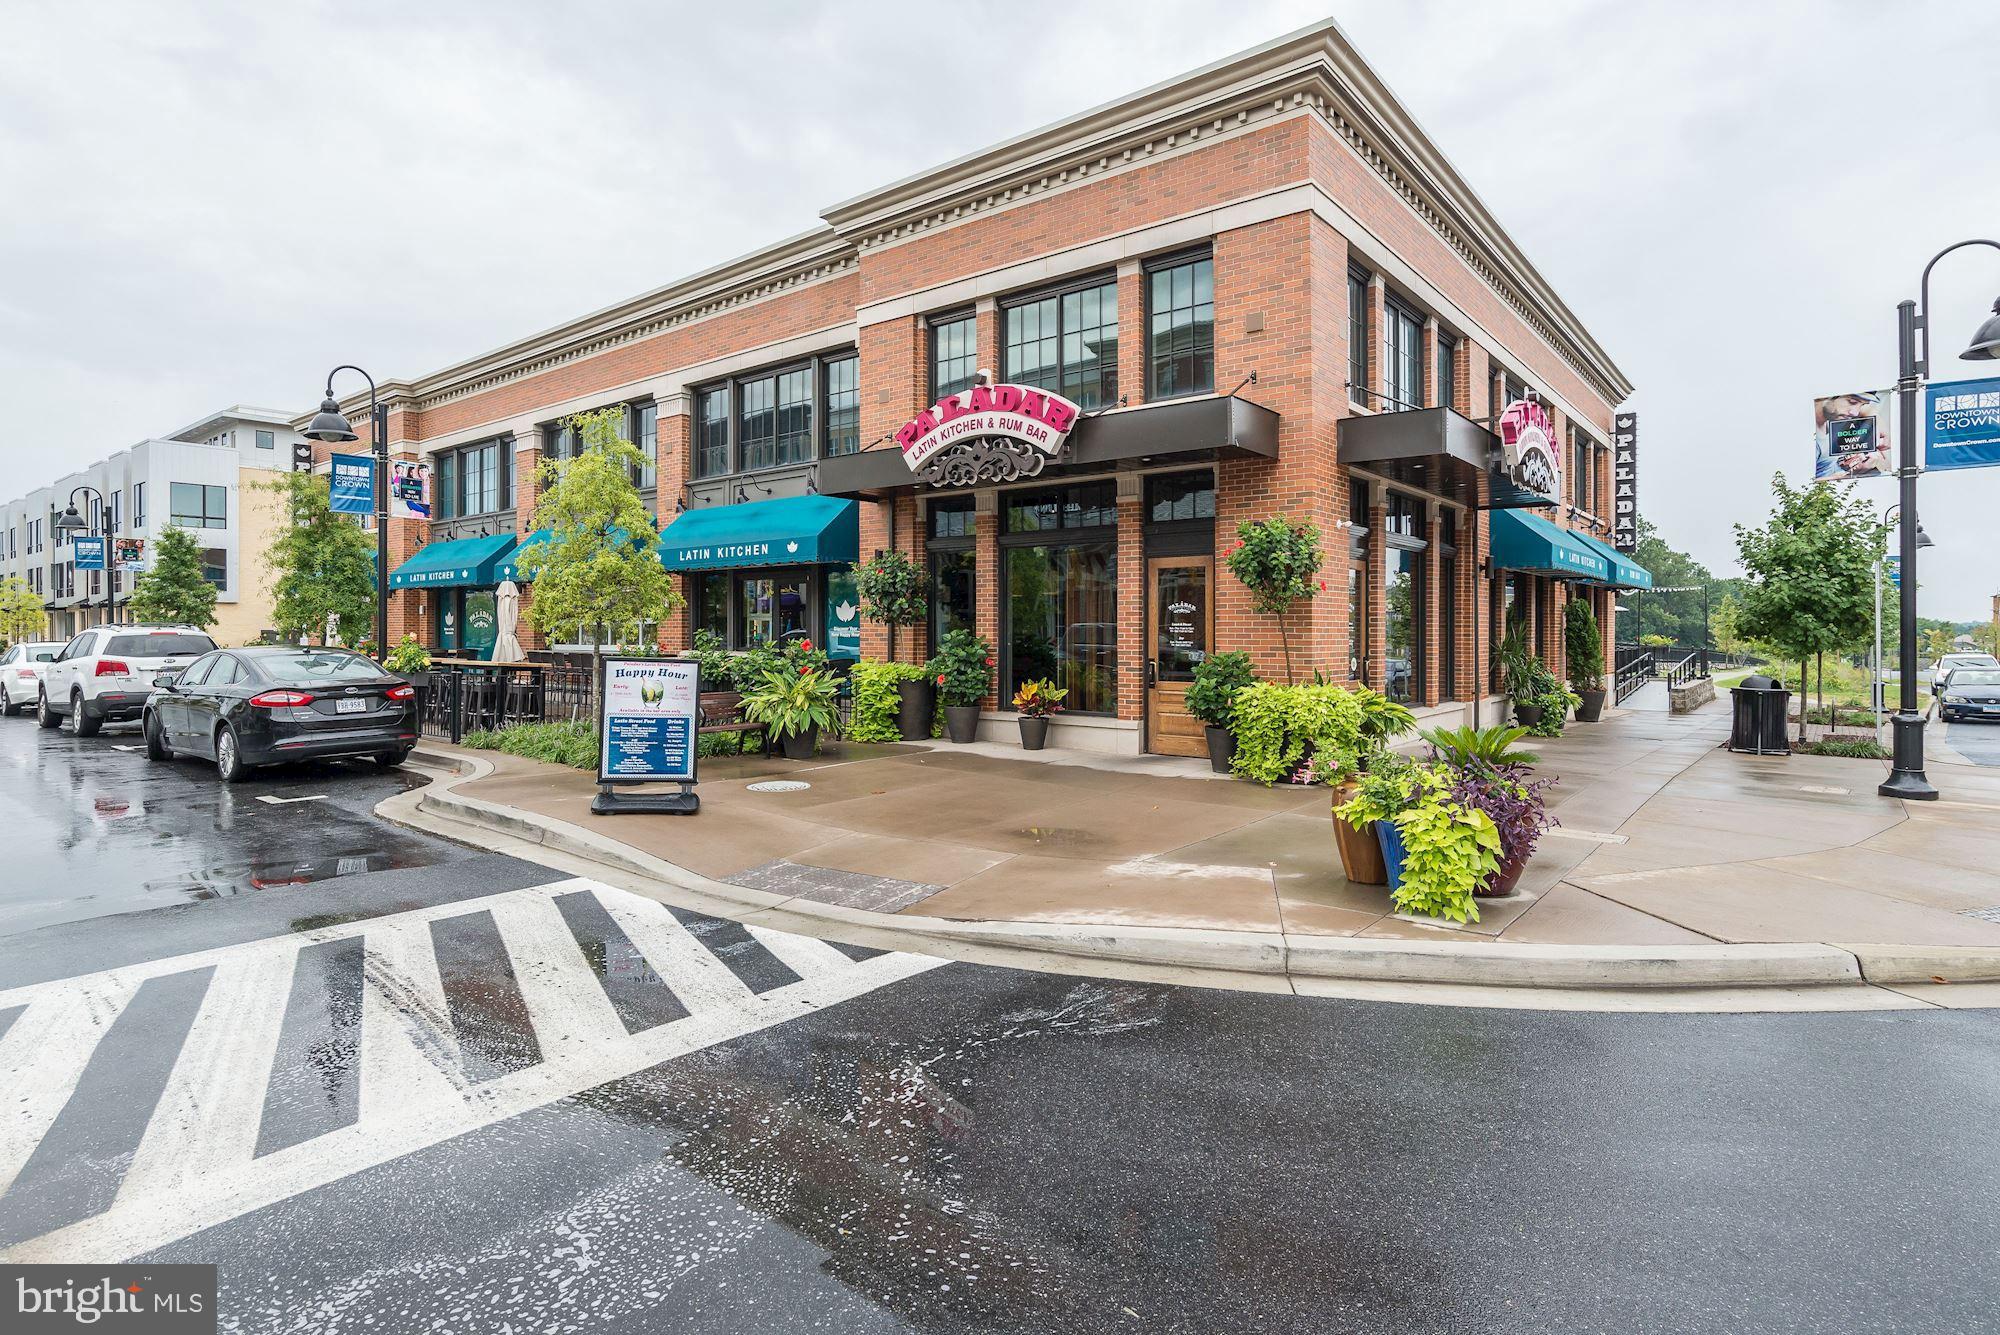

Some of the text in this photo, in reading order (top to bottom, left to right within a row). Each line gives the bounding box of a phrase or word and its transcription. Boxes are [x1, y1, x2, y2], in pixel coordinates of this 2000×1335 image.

[1935, 408, 1999, 421] DOWNTOWN
[1934, 416, 1999, 430] CROWN
[912, 418, 1048, 461] LATIN KITCHEN & RUM BAR
[1837, 429, 1868, 437] BOLDER
[335, 480, 370, 489] CROWN
[680, 544, 769, 561] LATIN KITCHEN
[1569, 552, 1596, 568] LATIN KITCHEN
[410, 571, 454, 582] LATIN KITCHEN
[616, 668, 688, 680] Happy Hour
